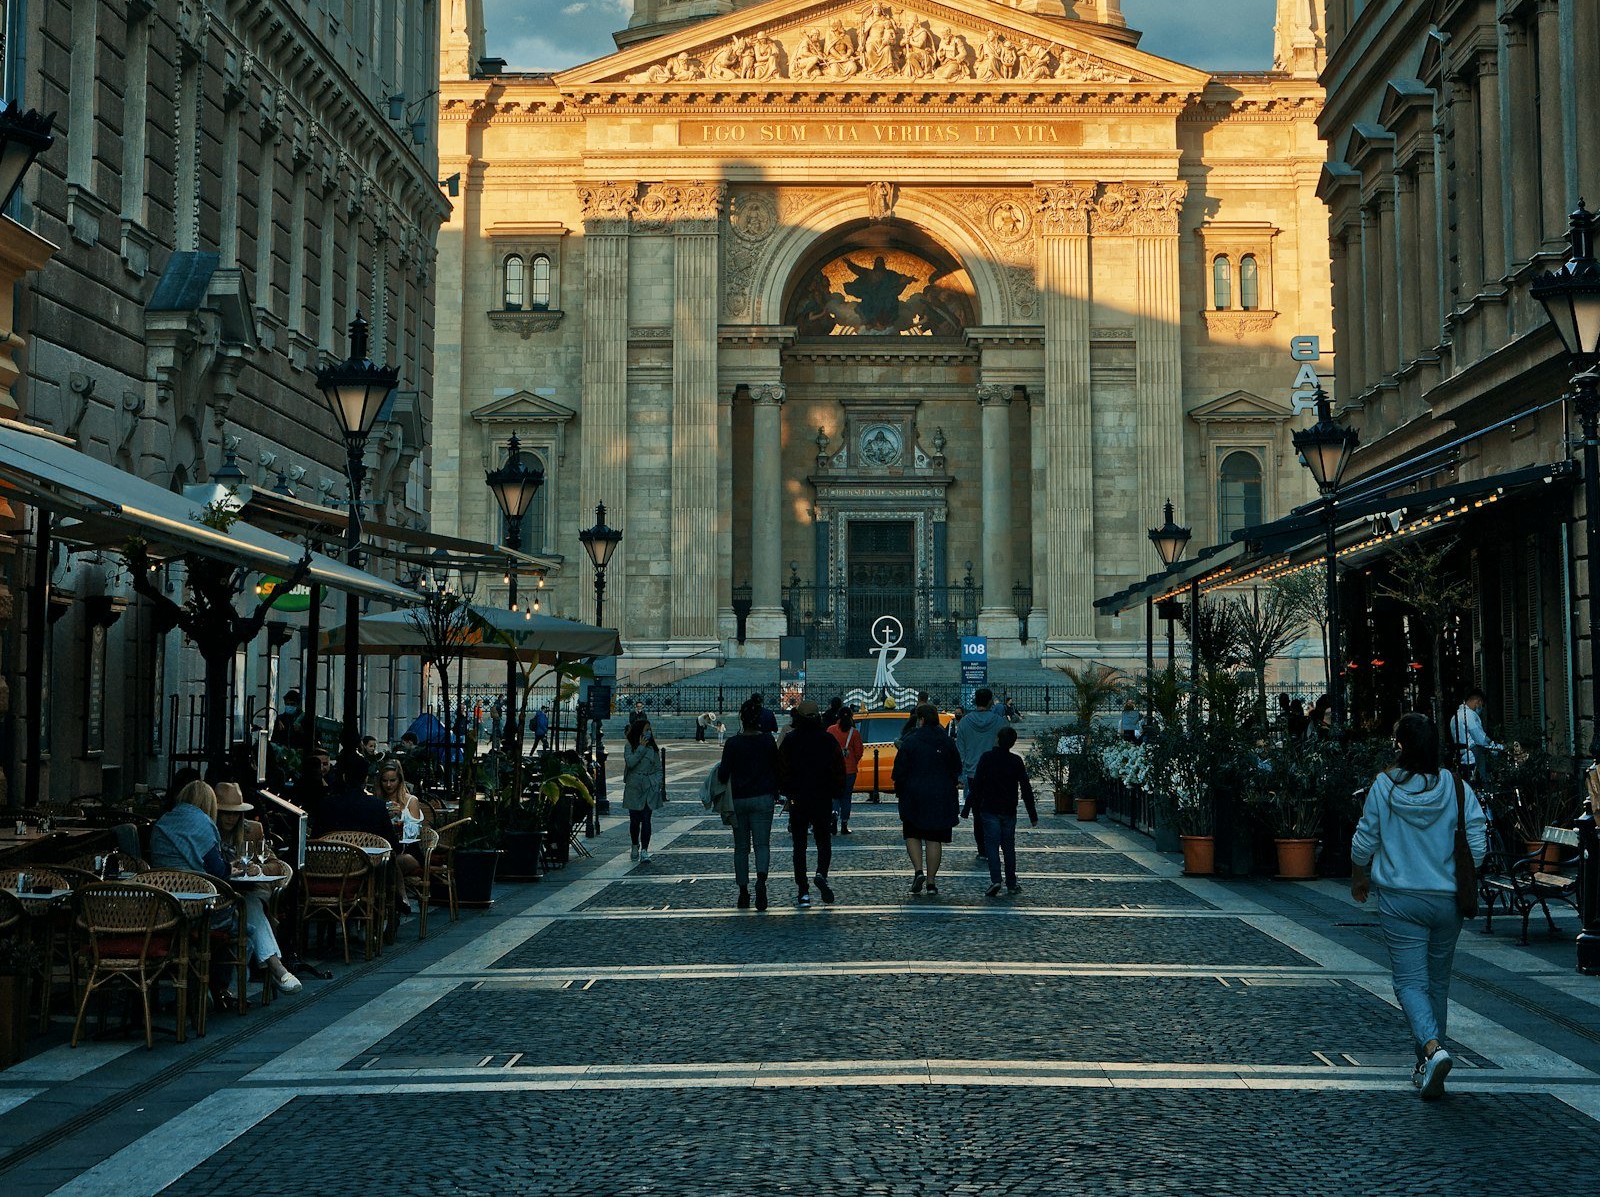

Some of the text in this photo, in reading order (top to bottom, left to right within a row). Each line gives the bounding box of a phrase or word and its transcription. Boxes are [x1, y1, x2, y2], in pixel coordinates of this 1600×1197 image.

[702, 124, 1059, 143] EGO SUM VIA VERITAS ET VITA
[963, 643, 986, 656] 108
